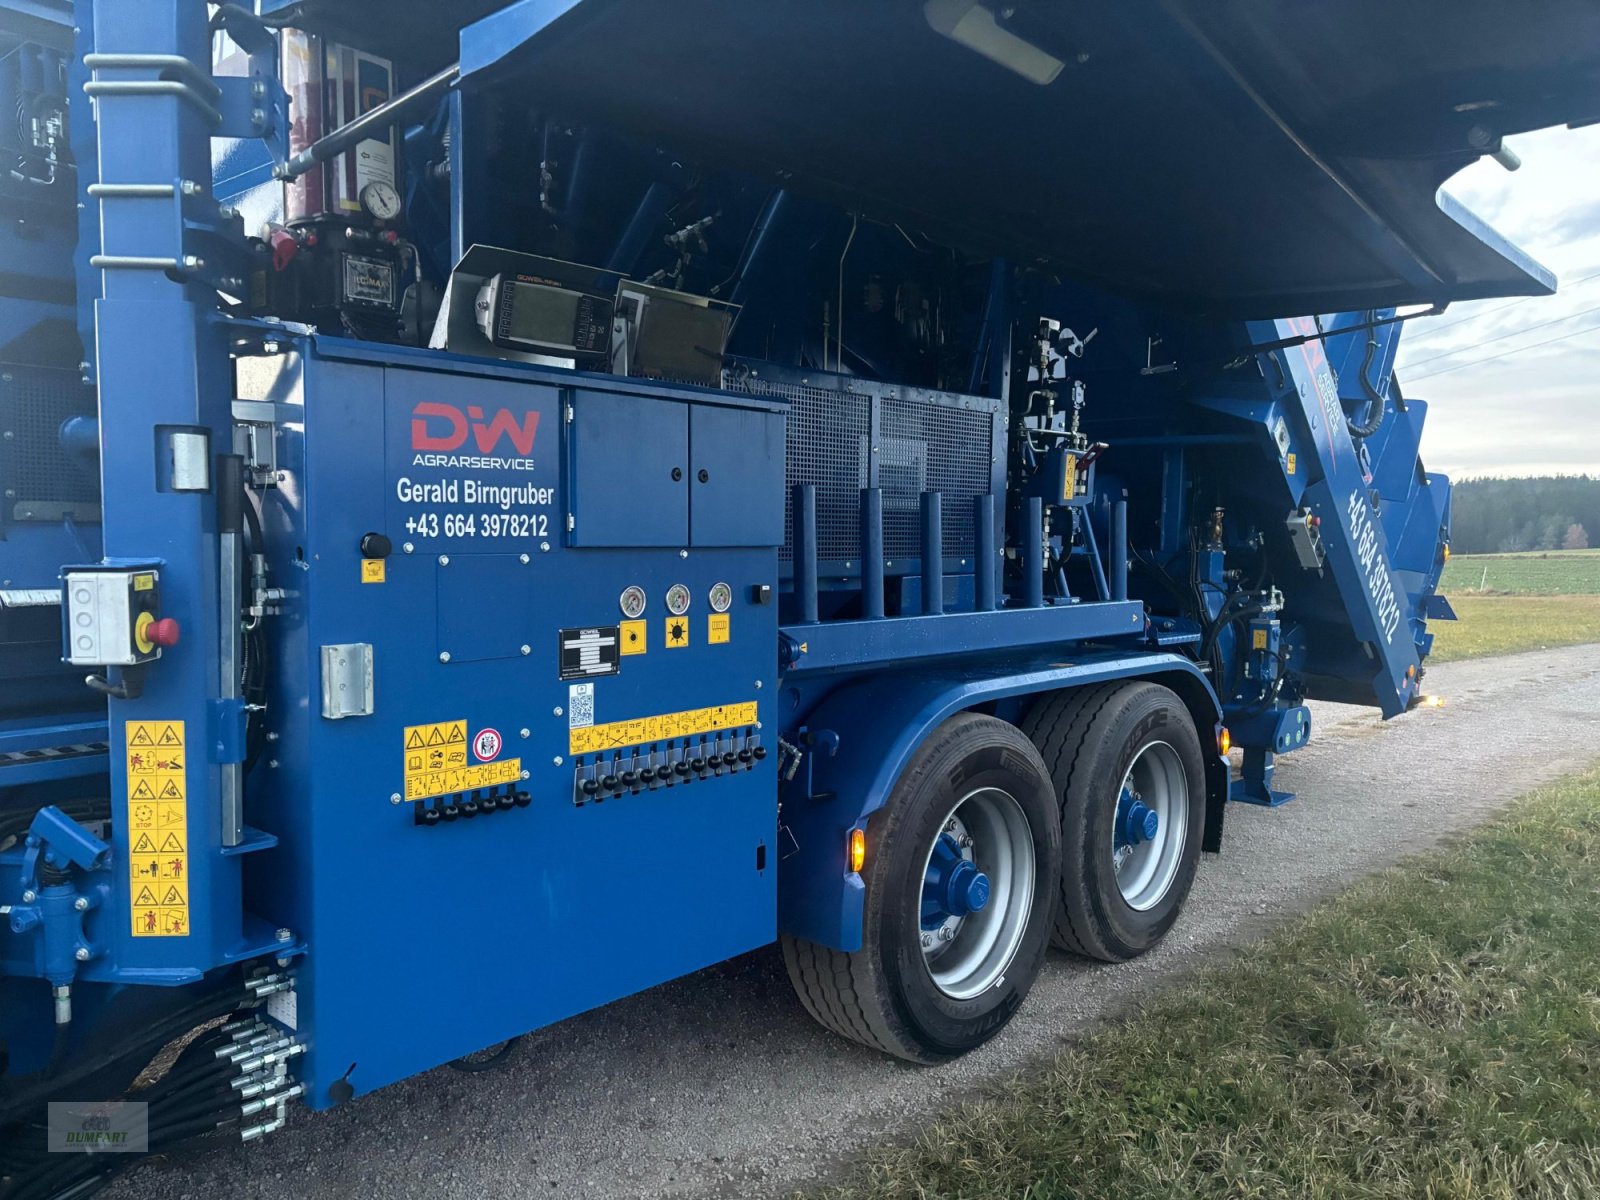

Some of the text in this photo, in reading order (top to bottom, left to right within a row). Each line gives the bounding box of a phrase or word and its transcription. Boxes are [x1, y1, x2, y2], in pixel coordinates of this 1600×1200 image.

[1317, 373, 1339, 437] SERVICE
[1322, 372, 1341, 422] AGRAR
[412, 454, 534, 470] AGRARSERVICE
[397, 477, 554, 510] Gerald Birngruber
[405, 513, 548, 537] +43 664 3978212
[1348, 488, 1401, 645] +43 664 3978212
